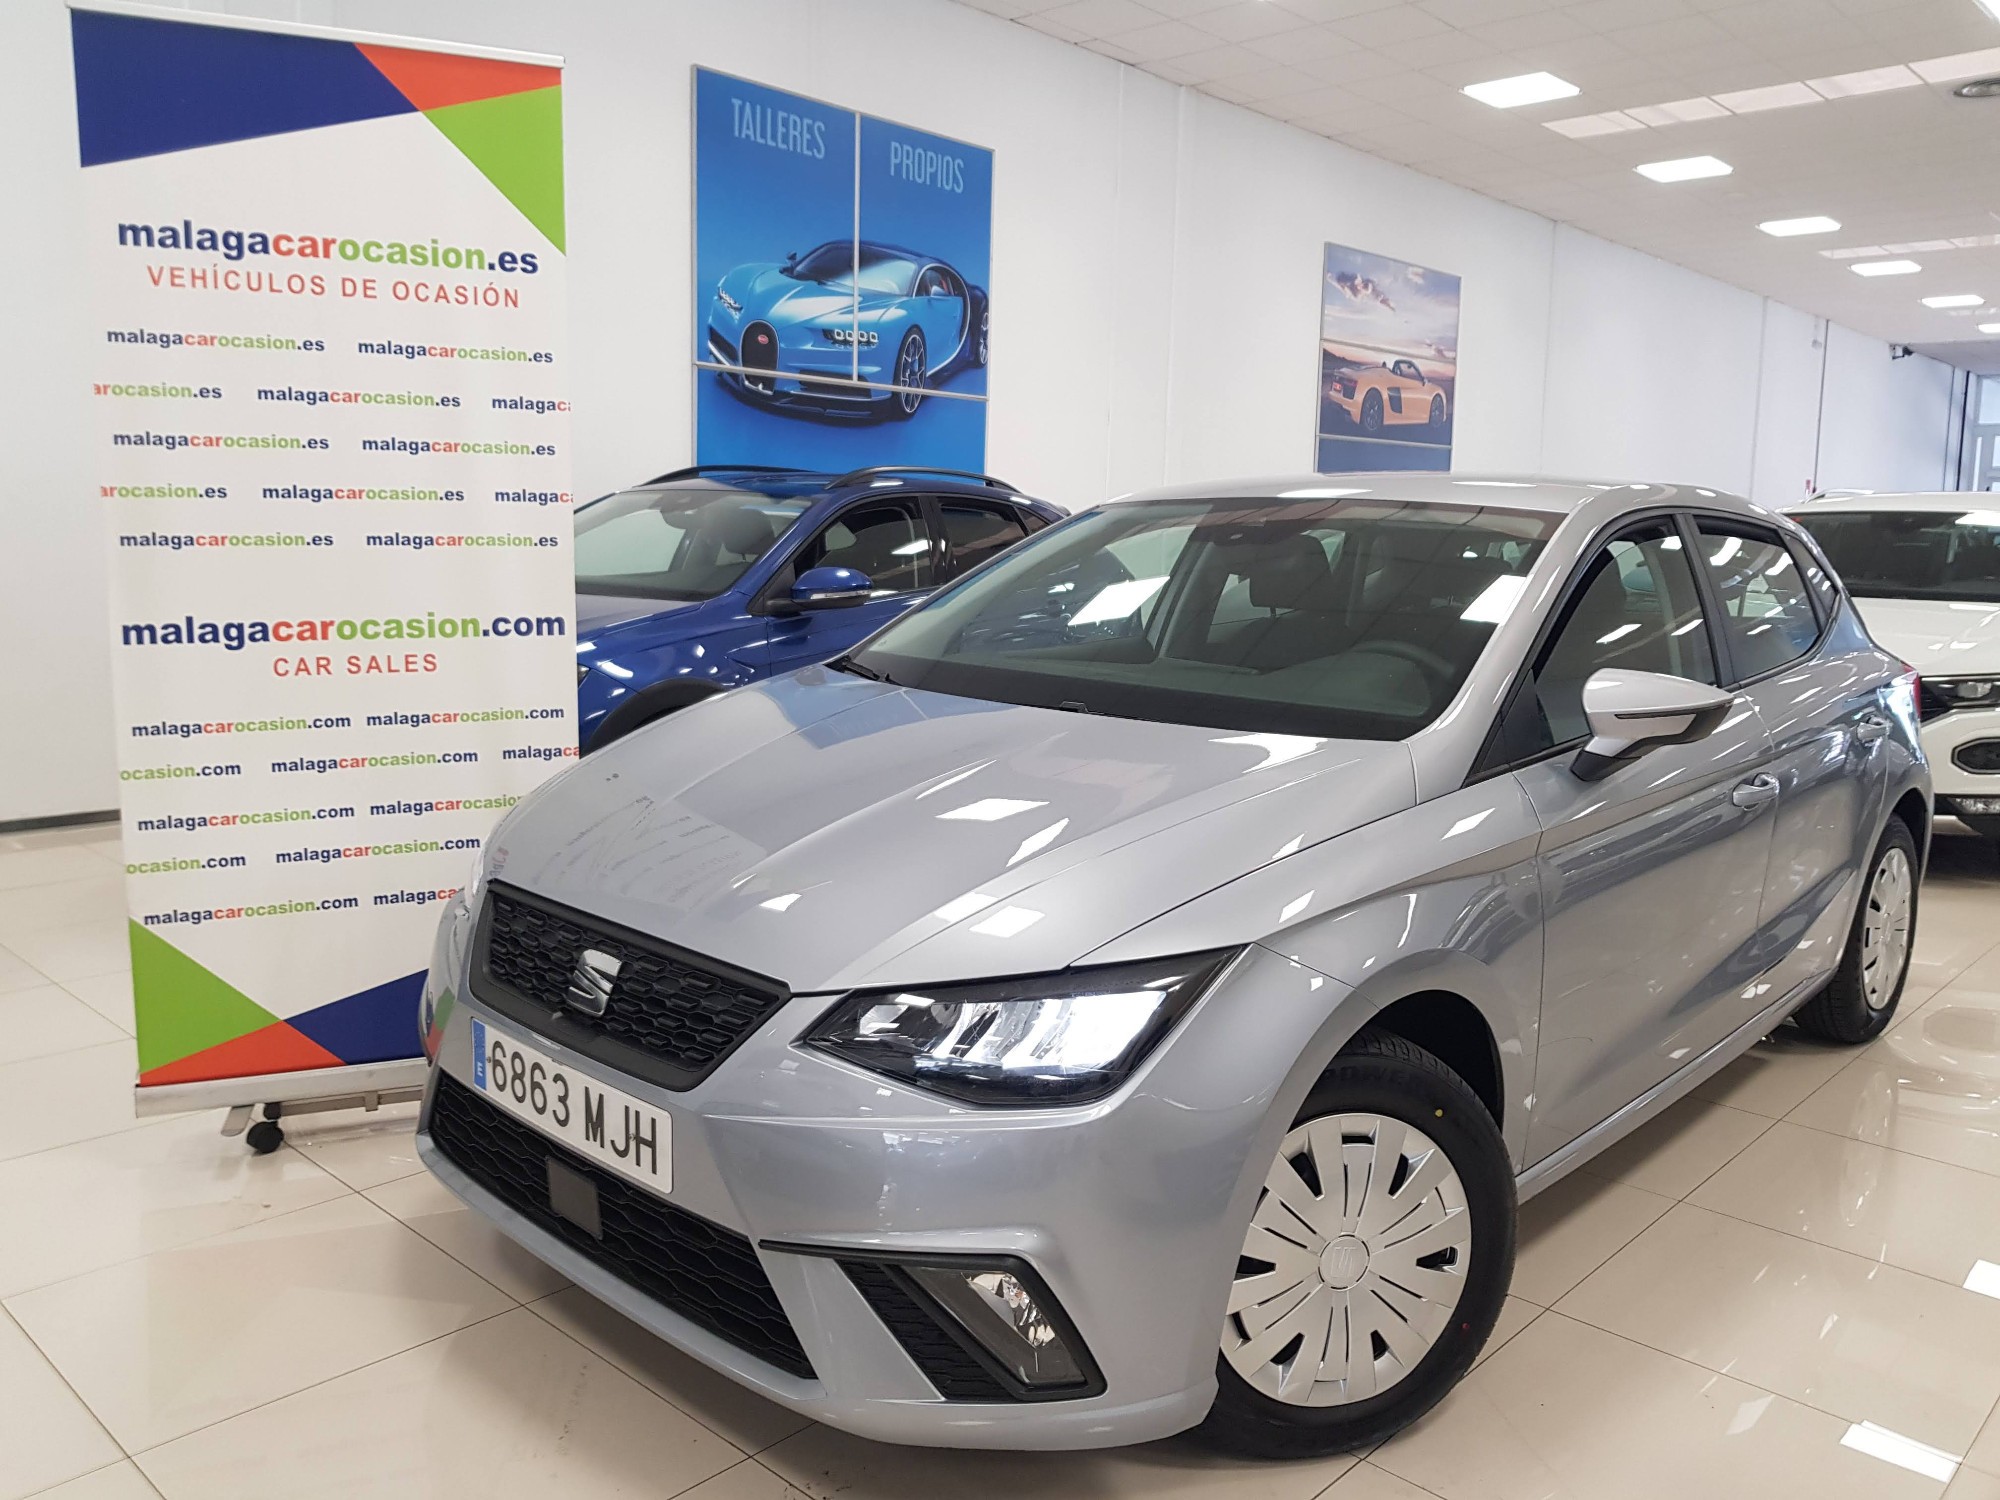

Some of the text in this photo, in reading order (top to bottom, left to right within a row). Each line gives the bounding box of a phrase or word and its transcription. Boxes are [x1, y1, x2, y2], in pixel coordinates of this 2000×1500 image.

[731, 97, 826, 160] TALLERES
[890, 140, 965, 194] PROPIOS
[117, 219, 539, 275] malagacarocasion.es
[147, 263, 520, 309] VEHÍCULOS DE OCASIÓN
[106, 328, 326, 352] malagacarocasion.es
[357, 340, 554, 364] malagacarocasion.es
[257, 385, 461, 408] malagacarocasion.es
[113, 430, 330, 451] malagacarocasion.es
[362, 436, 556, 456] malagacarocasion.es
[262, 484, 465, 503] malagacarocasion.es
[494, 488, 574, 507] malagac
[119, 531, 334, 551] malagacarocasion.es
[366, 531, 559, 550] malagacarocasion.es
[121, 611, 566, 651] malagacarocasion.com
[273, 653, 438, 678] CAR SALES
[131, 716, 352, 739] malagacarocasion.com
[366, 706, 565, 728] malagacarocasion.com
[120, 764, 242, 781] ocasion.com
[271, 751, 479, 774] malagacarocasion.com
[137, 806, 355, 832] malagacarocasion.com
[275, 837, 481, 864] malagacarocasion.com
[126, 855, 247, 875] ocasion.com
[143, 897, 359, 926] malagacarocasion.com
[491, 1040, 658, 1176] 6863 MJH
